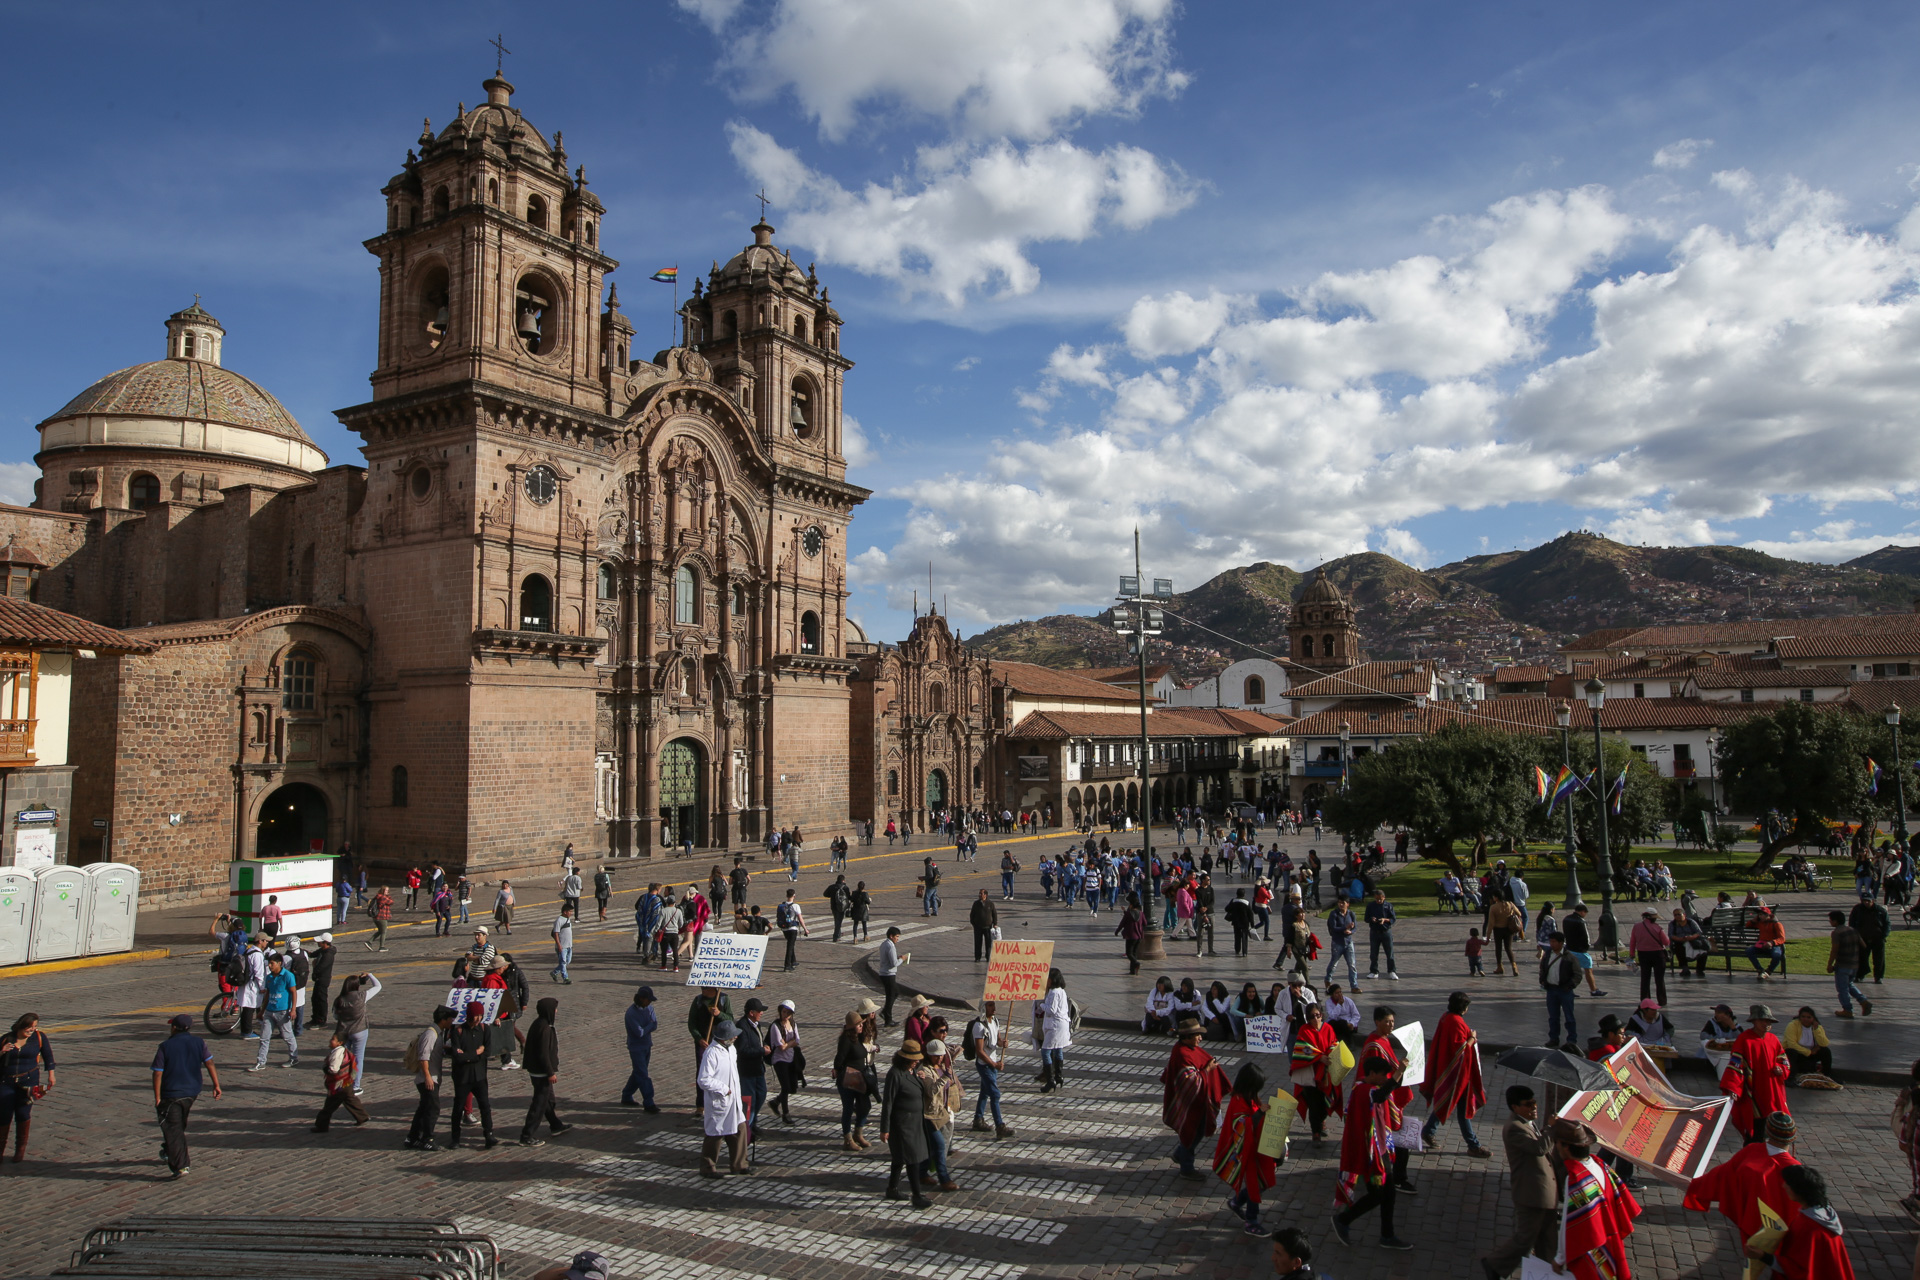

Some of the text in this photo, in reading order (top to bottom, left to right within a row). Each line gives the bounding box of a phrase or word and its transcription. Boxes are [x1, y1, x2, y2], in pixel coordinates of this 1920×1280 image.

[701, 936, 733, 945] SEÑOR
[699, 947, 760, 957] PRESIDENTE
[995, 942, 1036, 955] VIVA LA
[693, 962, 751, 970] NECESITAMOS
[988, 962, 1050, 973] UNIVERSIDAD
[697, 980, 742, 988] UNIVERSIDAD
[987, 973, 1042, 992] DEL ARTE
[999, 993, 1037, 1001] CUSCO
[1631, 1112, 1656, 1145] QUISPE
